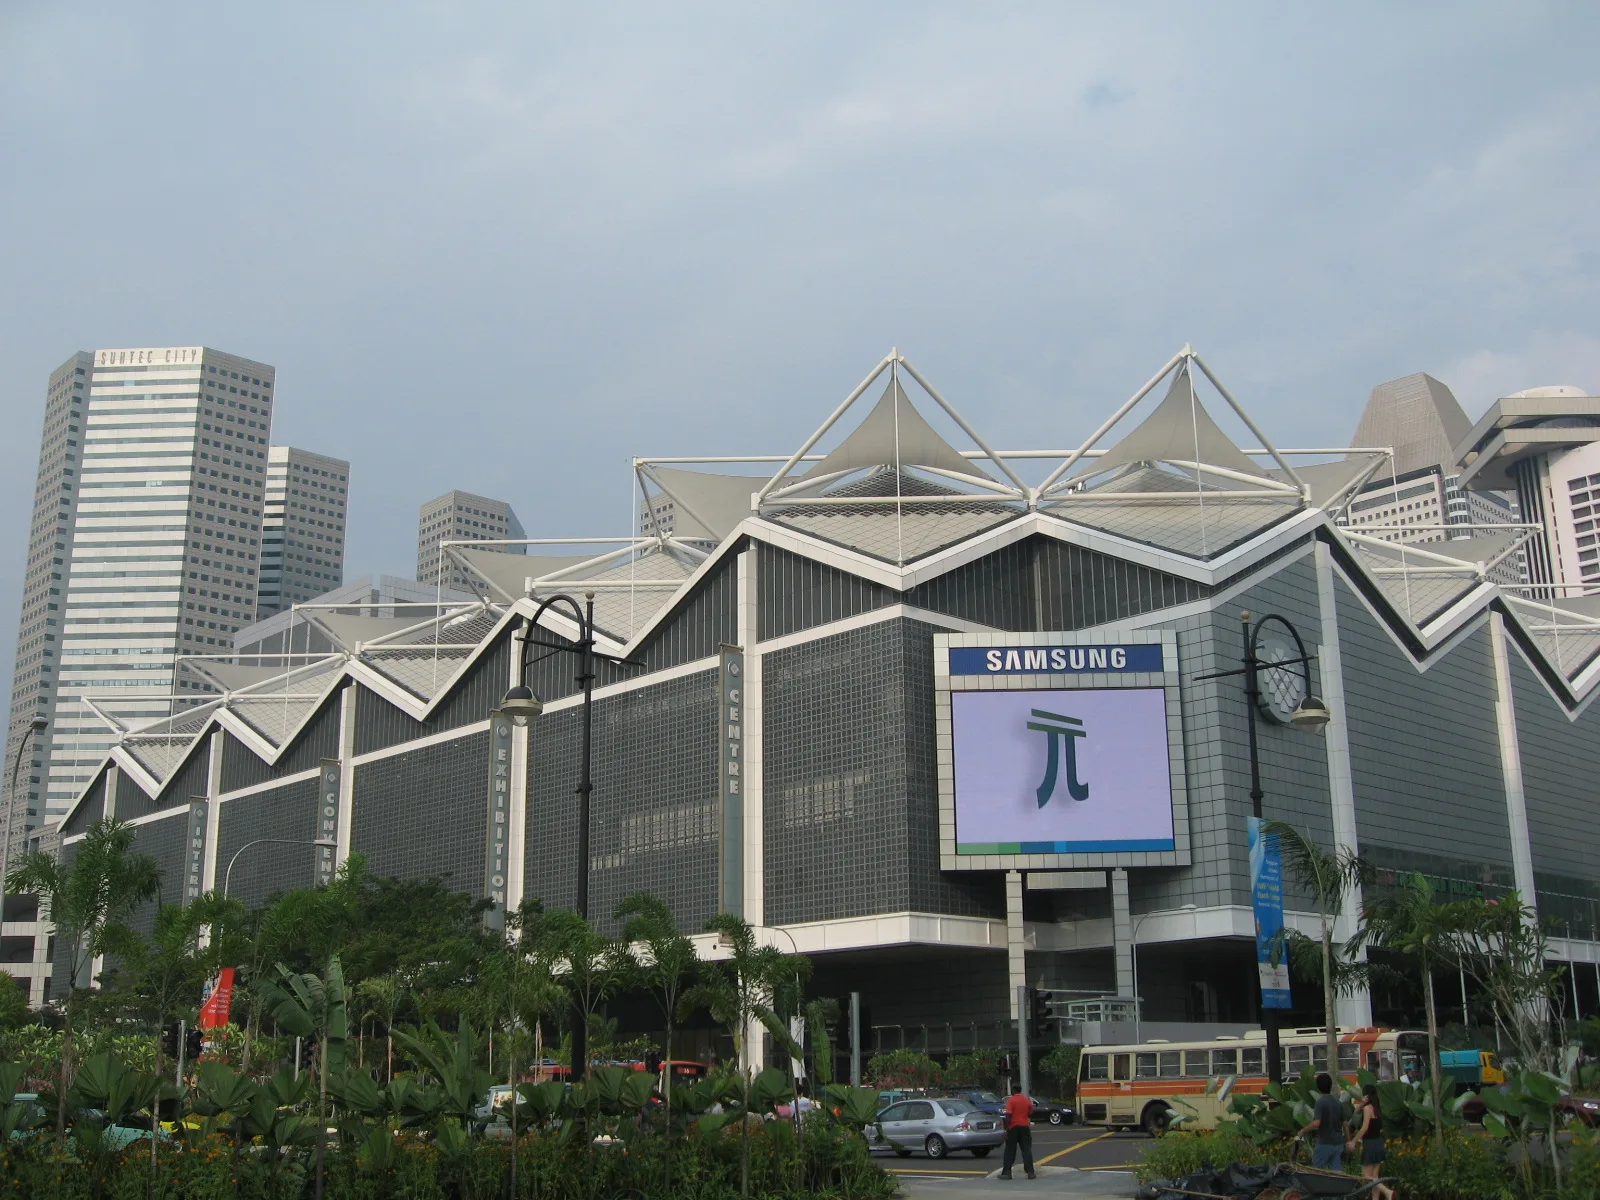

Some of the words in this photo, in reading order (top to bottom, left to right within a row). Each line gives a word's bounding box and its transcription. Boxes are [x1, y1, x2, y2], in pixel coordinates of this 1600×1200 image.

[100, 351, 153, 365] SUNTEC
[165, 349, 197, 363] CITY
[986, 647, 1127, 672] SAMSUNG
[728, 689, 740, 795] CENTRE
[188, 826, 203, 907] INTERN
[491, 748, 507, 904] EXHIBITION
